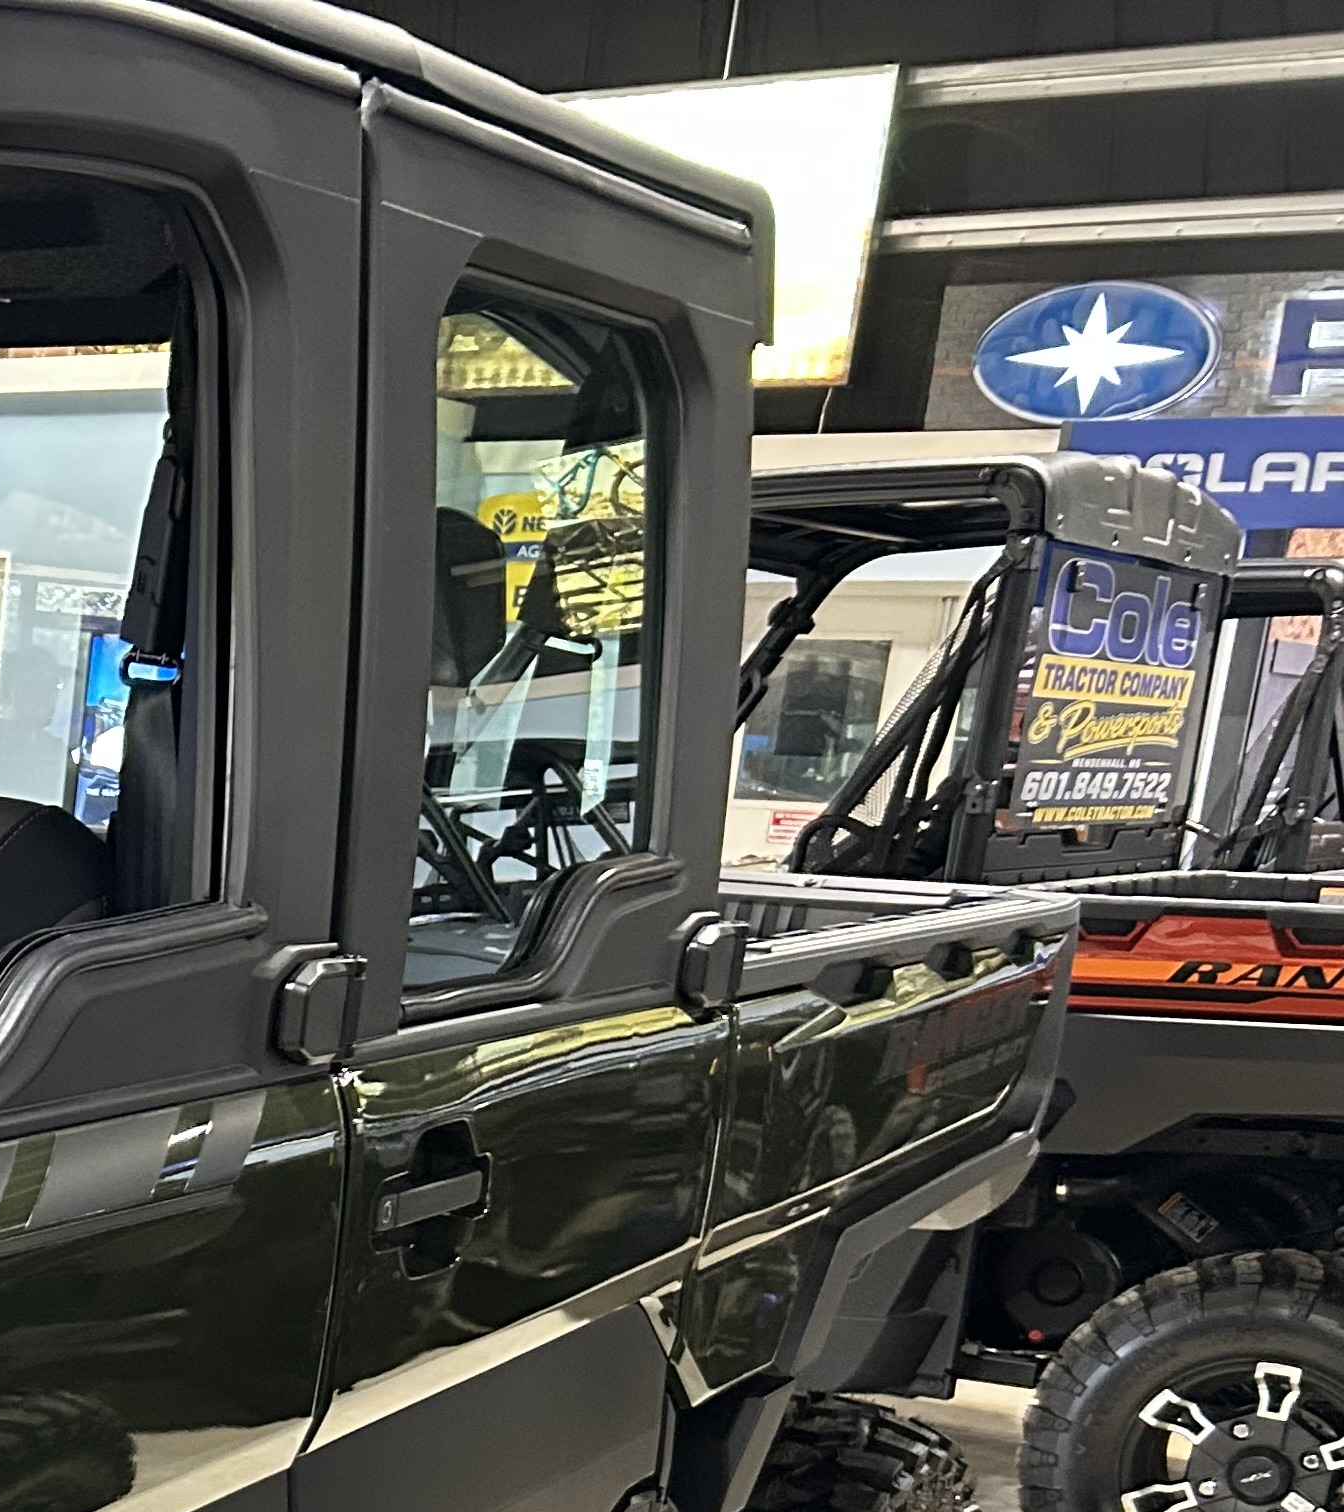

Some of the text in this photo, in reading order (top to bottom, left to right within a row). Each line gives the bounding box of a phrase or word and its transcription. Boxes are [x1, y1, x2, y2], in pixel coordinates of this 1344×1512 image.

[1049, 557, 1201, 668] Cole
[1043, 663, 1190, 701] TRACTOR COMPANY
[1027, 699, 1185, 755] & Powersports
[1021, 771, 1172, 801] 601.849.7522
